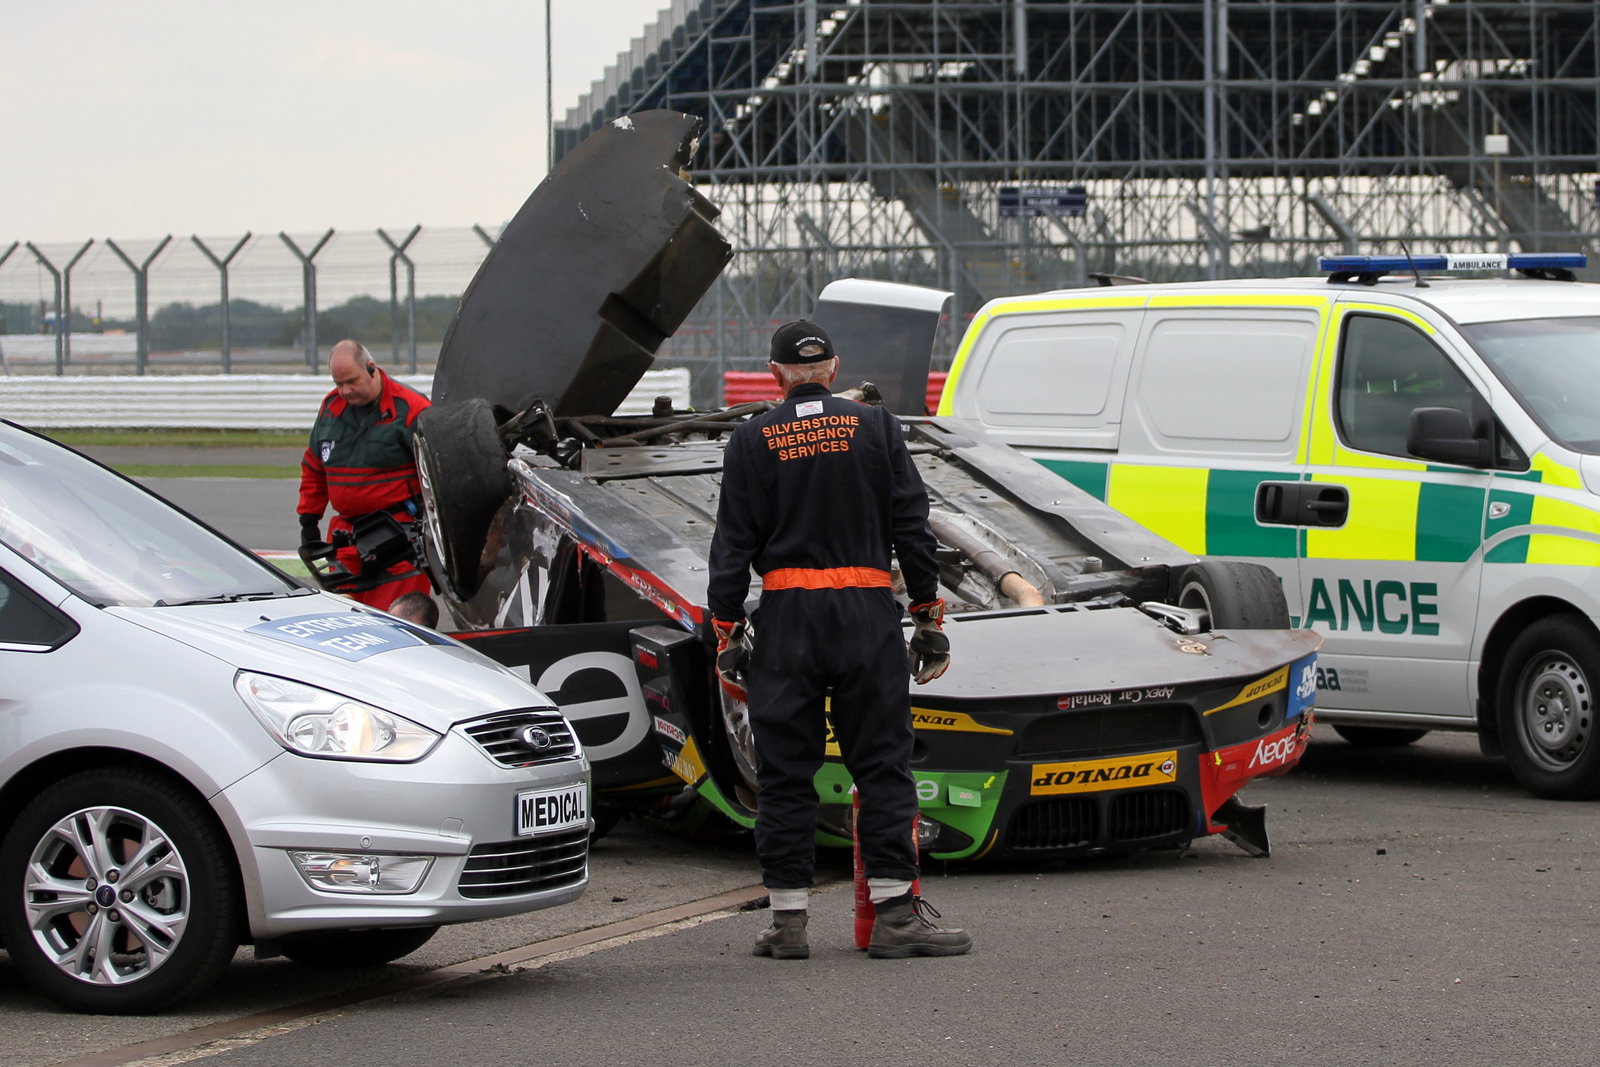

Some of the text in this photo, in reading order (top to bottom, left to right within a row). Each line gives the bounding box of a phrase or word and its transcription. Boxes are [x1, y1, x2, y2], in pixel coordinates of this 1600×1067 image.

[1453, 261, 1502, 270] AMBULANCE
[761, 415, 859, 438] SILVERSTONE
[767, 427, 856, 451] EMERGENCY
[778, 440, 849, 461] SERVICES
[318, 632, 389, 653] TEAM
[1119, 689, 1142, 703] Car
[1245, 674, 1283, 698] DUNLOP
[1248, 732, 1297, 769] ebay
[1033, 763, 1154, 787] DUNLOP
[521, 790, 586, 829] MEDICAL
